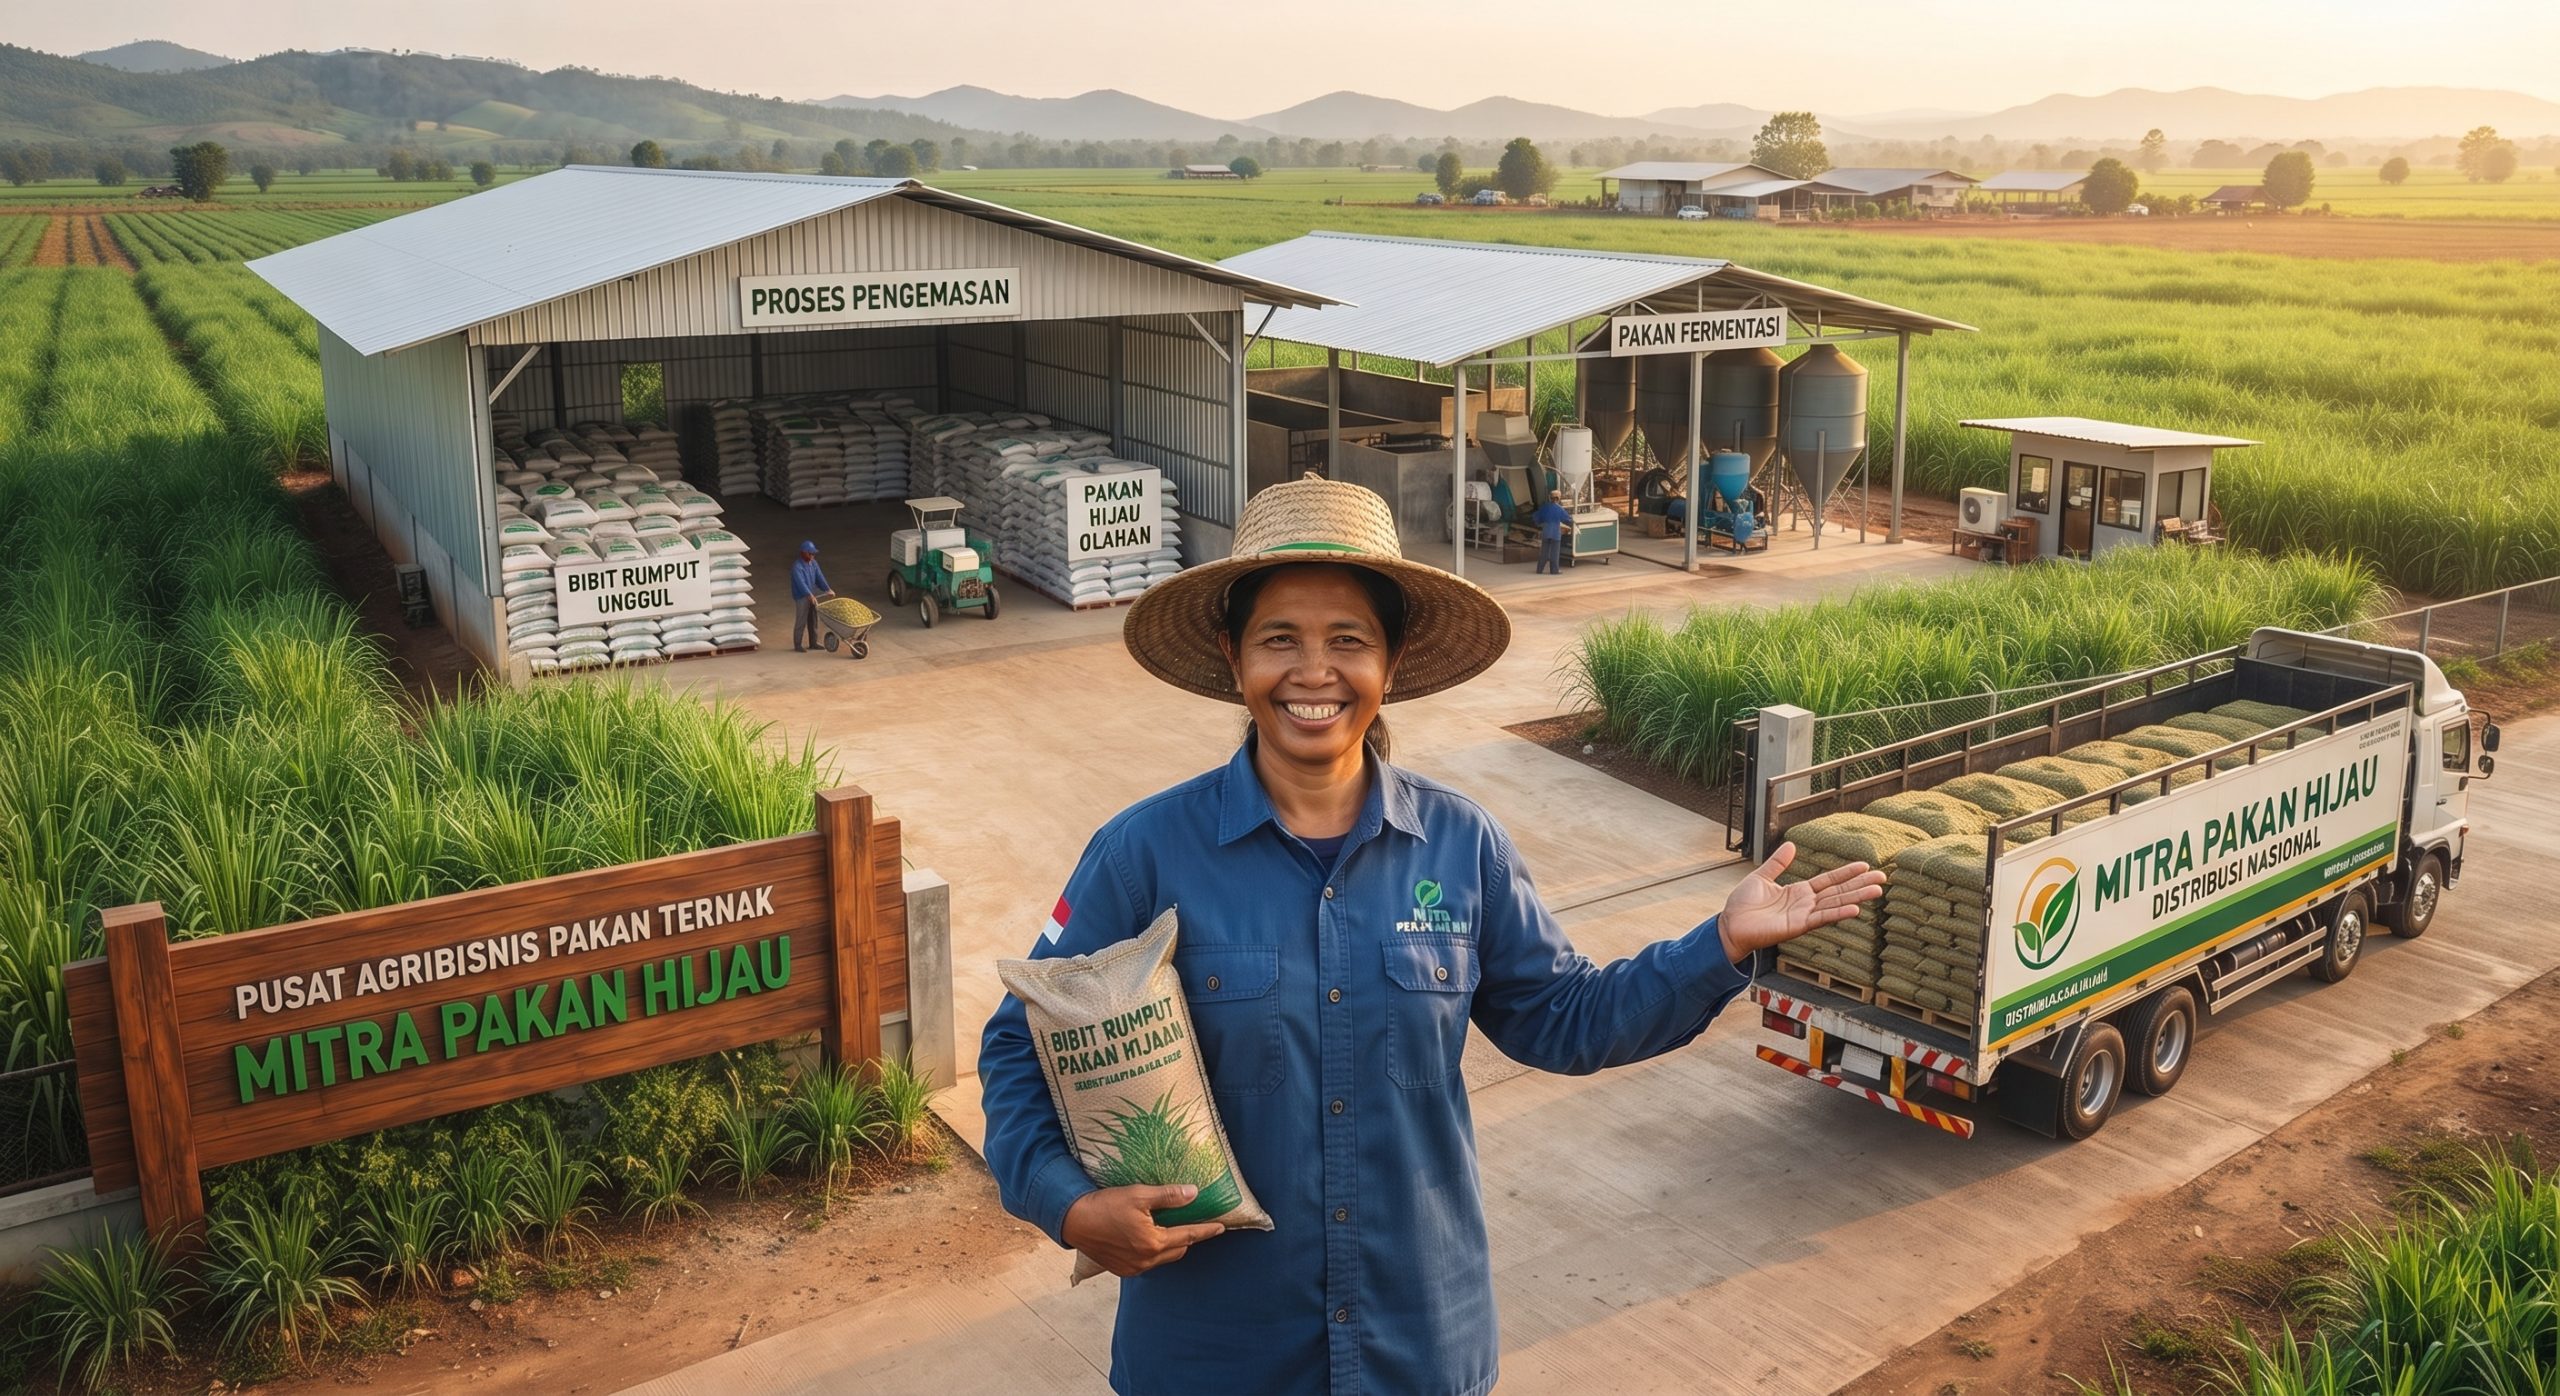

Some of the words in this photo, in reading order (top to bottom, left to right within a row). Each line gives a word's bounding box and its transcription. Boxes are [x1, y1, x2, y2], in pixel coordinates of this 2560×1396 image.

[752, 285, 845, 315] PROSES
[853, 279, 1009, 310] PENGEMASAN
[1619, 322, 1675, 347] PAKAN
[1681, 315, 1780, 343] FERMENTASI
[1084, 479, 1143, 503] PAKAN
[1089, 504, 1140, 526] HIJAU
[1079, 525, 1151, 552] OLAHAN
[568, 569, 618, 592] BIBIT
[622, 560, 700, 587] RUMPUT
[597, 588, 674, 614] UNGGUL
[2095, 830, 2193, 912] MITRA
[2202, 786, 2297, 865] PAKAN
[2303, 754, 2379, 822] HIJAU
[2152, 861, 2243, 920] DISTRIBUSI
[2249, 826, 2321, 879] NASIONAL
[236, 967, 346, 1020] PUSAT
[356, 931, 540, 996] AGRIBISNIS
[549, 910, 651, 958] PAKAN
[658, 885, 775, 936] TERNAK
[234, 1011, 430, 1104] MITRA
[441, 969, 628, 1060] PAKAN
[643, 935, 792, 1017] HIJAU
[1050, 1024, 1097, 1053] BIBIT
[1101, 997, 1172, 1041] RUMPUT
[1057, 1044, 1119, 1076] PAKAN
